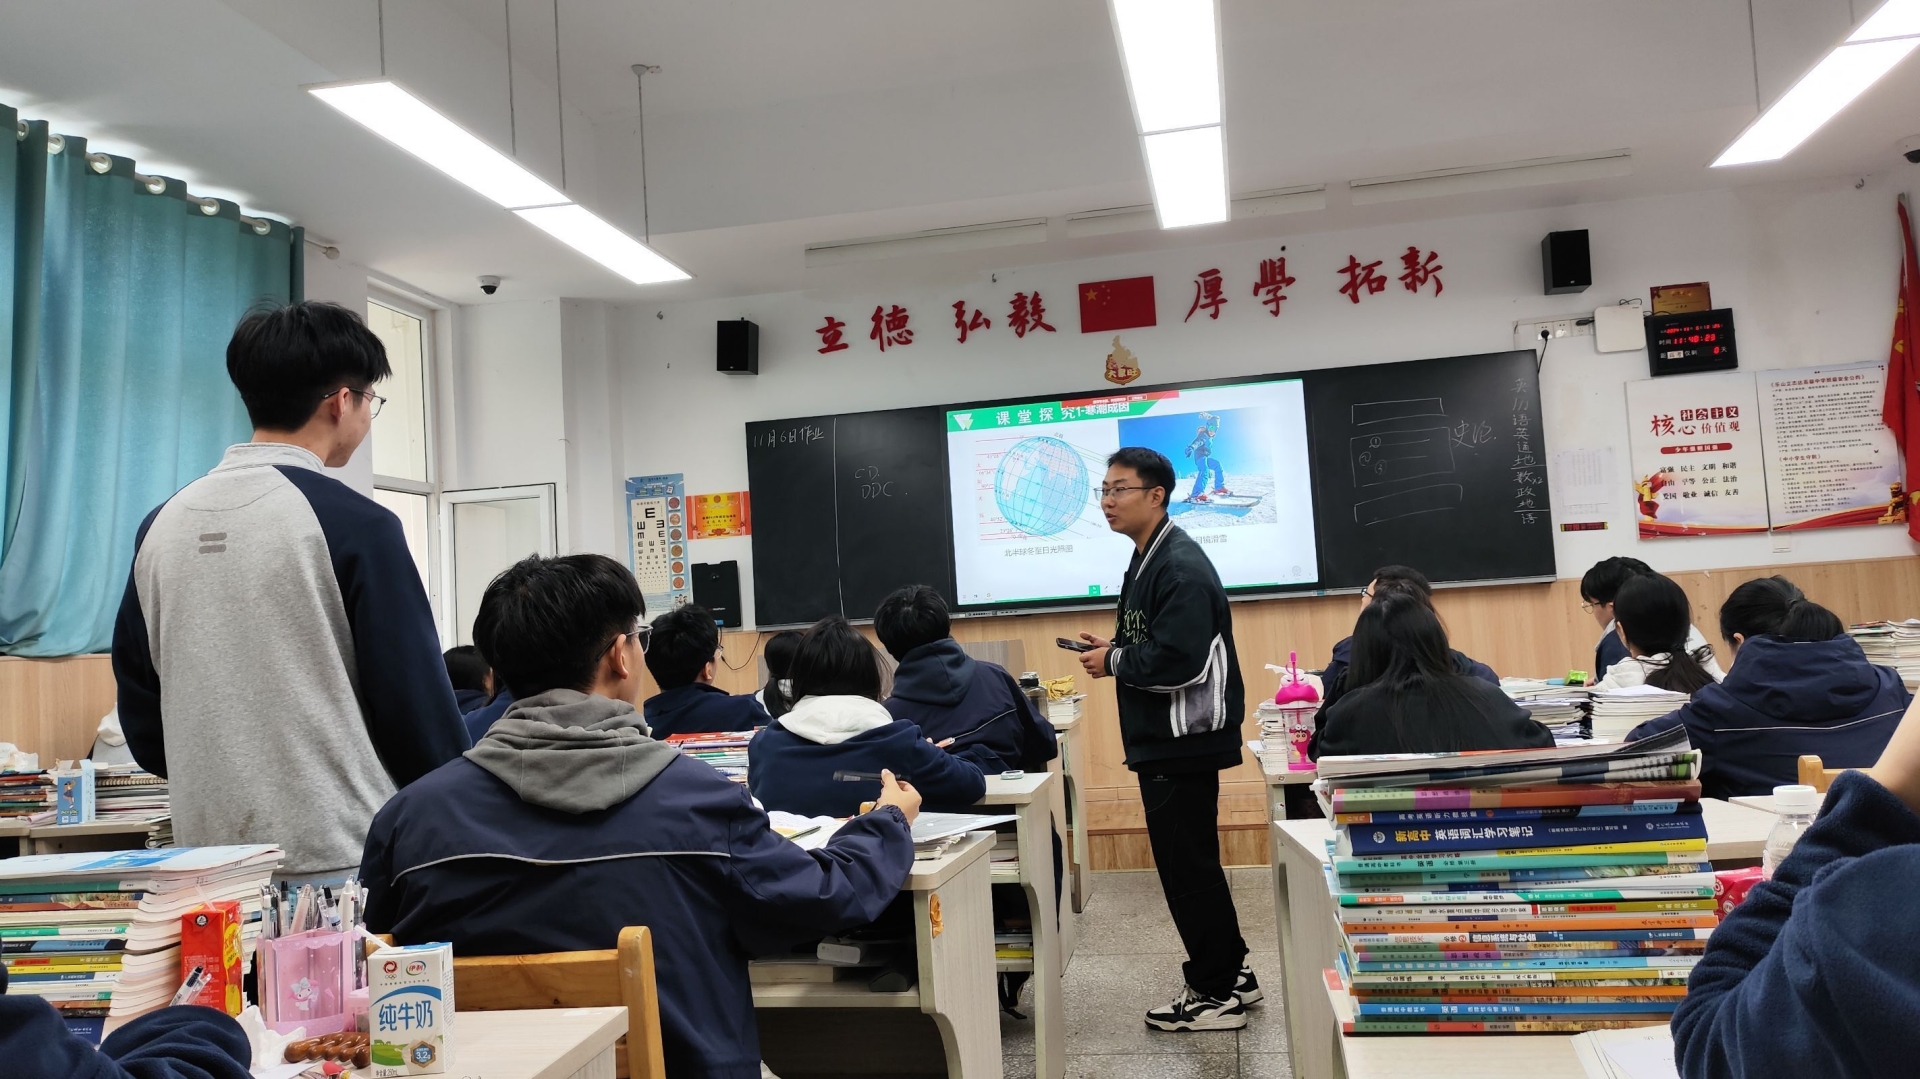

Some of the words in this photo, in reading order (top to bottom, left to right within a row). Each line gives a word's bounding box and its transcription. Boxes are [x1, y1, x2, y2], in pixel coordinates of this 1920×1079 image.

[1680, 405, 1739, 421] 社会主义
[1660, 466, 1675, 474] 富强
[1680, 465, 1695, 473] 民主
[1701, 463, 1716, 471] 文明
[1722, 462, 1737, 470] 和谐
[1723, 475, 1737, 483] 法治
[1683, 491, 1697, 499] 敬业
[1725, 488, 1739, 496] 友善
[1192, 534, 1228, 545] 目镜滑雪
[1395, 829, 1432, 843] 新高中
[1434, 825, 1534, 841] 英语词汇学习笔记
[1417, 860, 1434, 868] 英语
[1394, 935, 1425, 944] 信息技术
[1472, 933, 1537, 943] 信息系统与社会
[408, 964, 424, 972] 伊利
[1441, 1005, 1458, 1013] 英语
[378, 1000, 433, 1032] 纯牛奶
